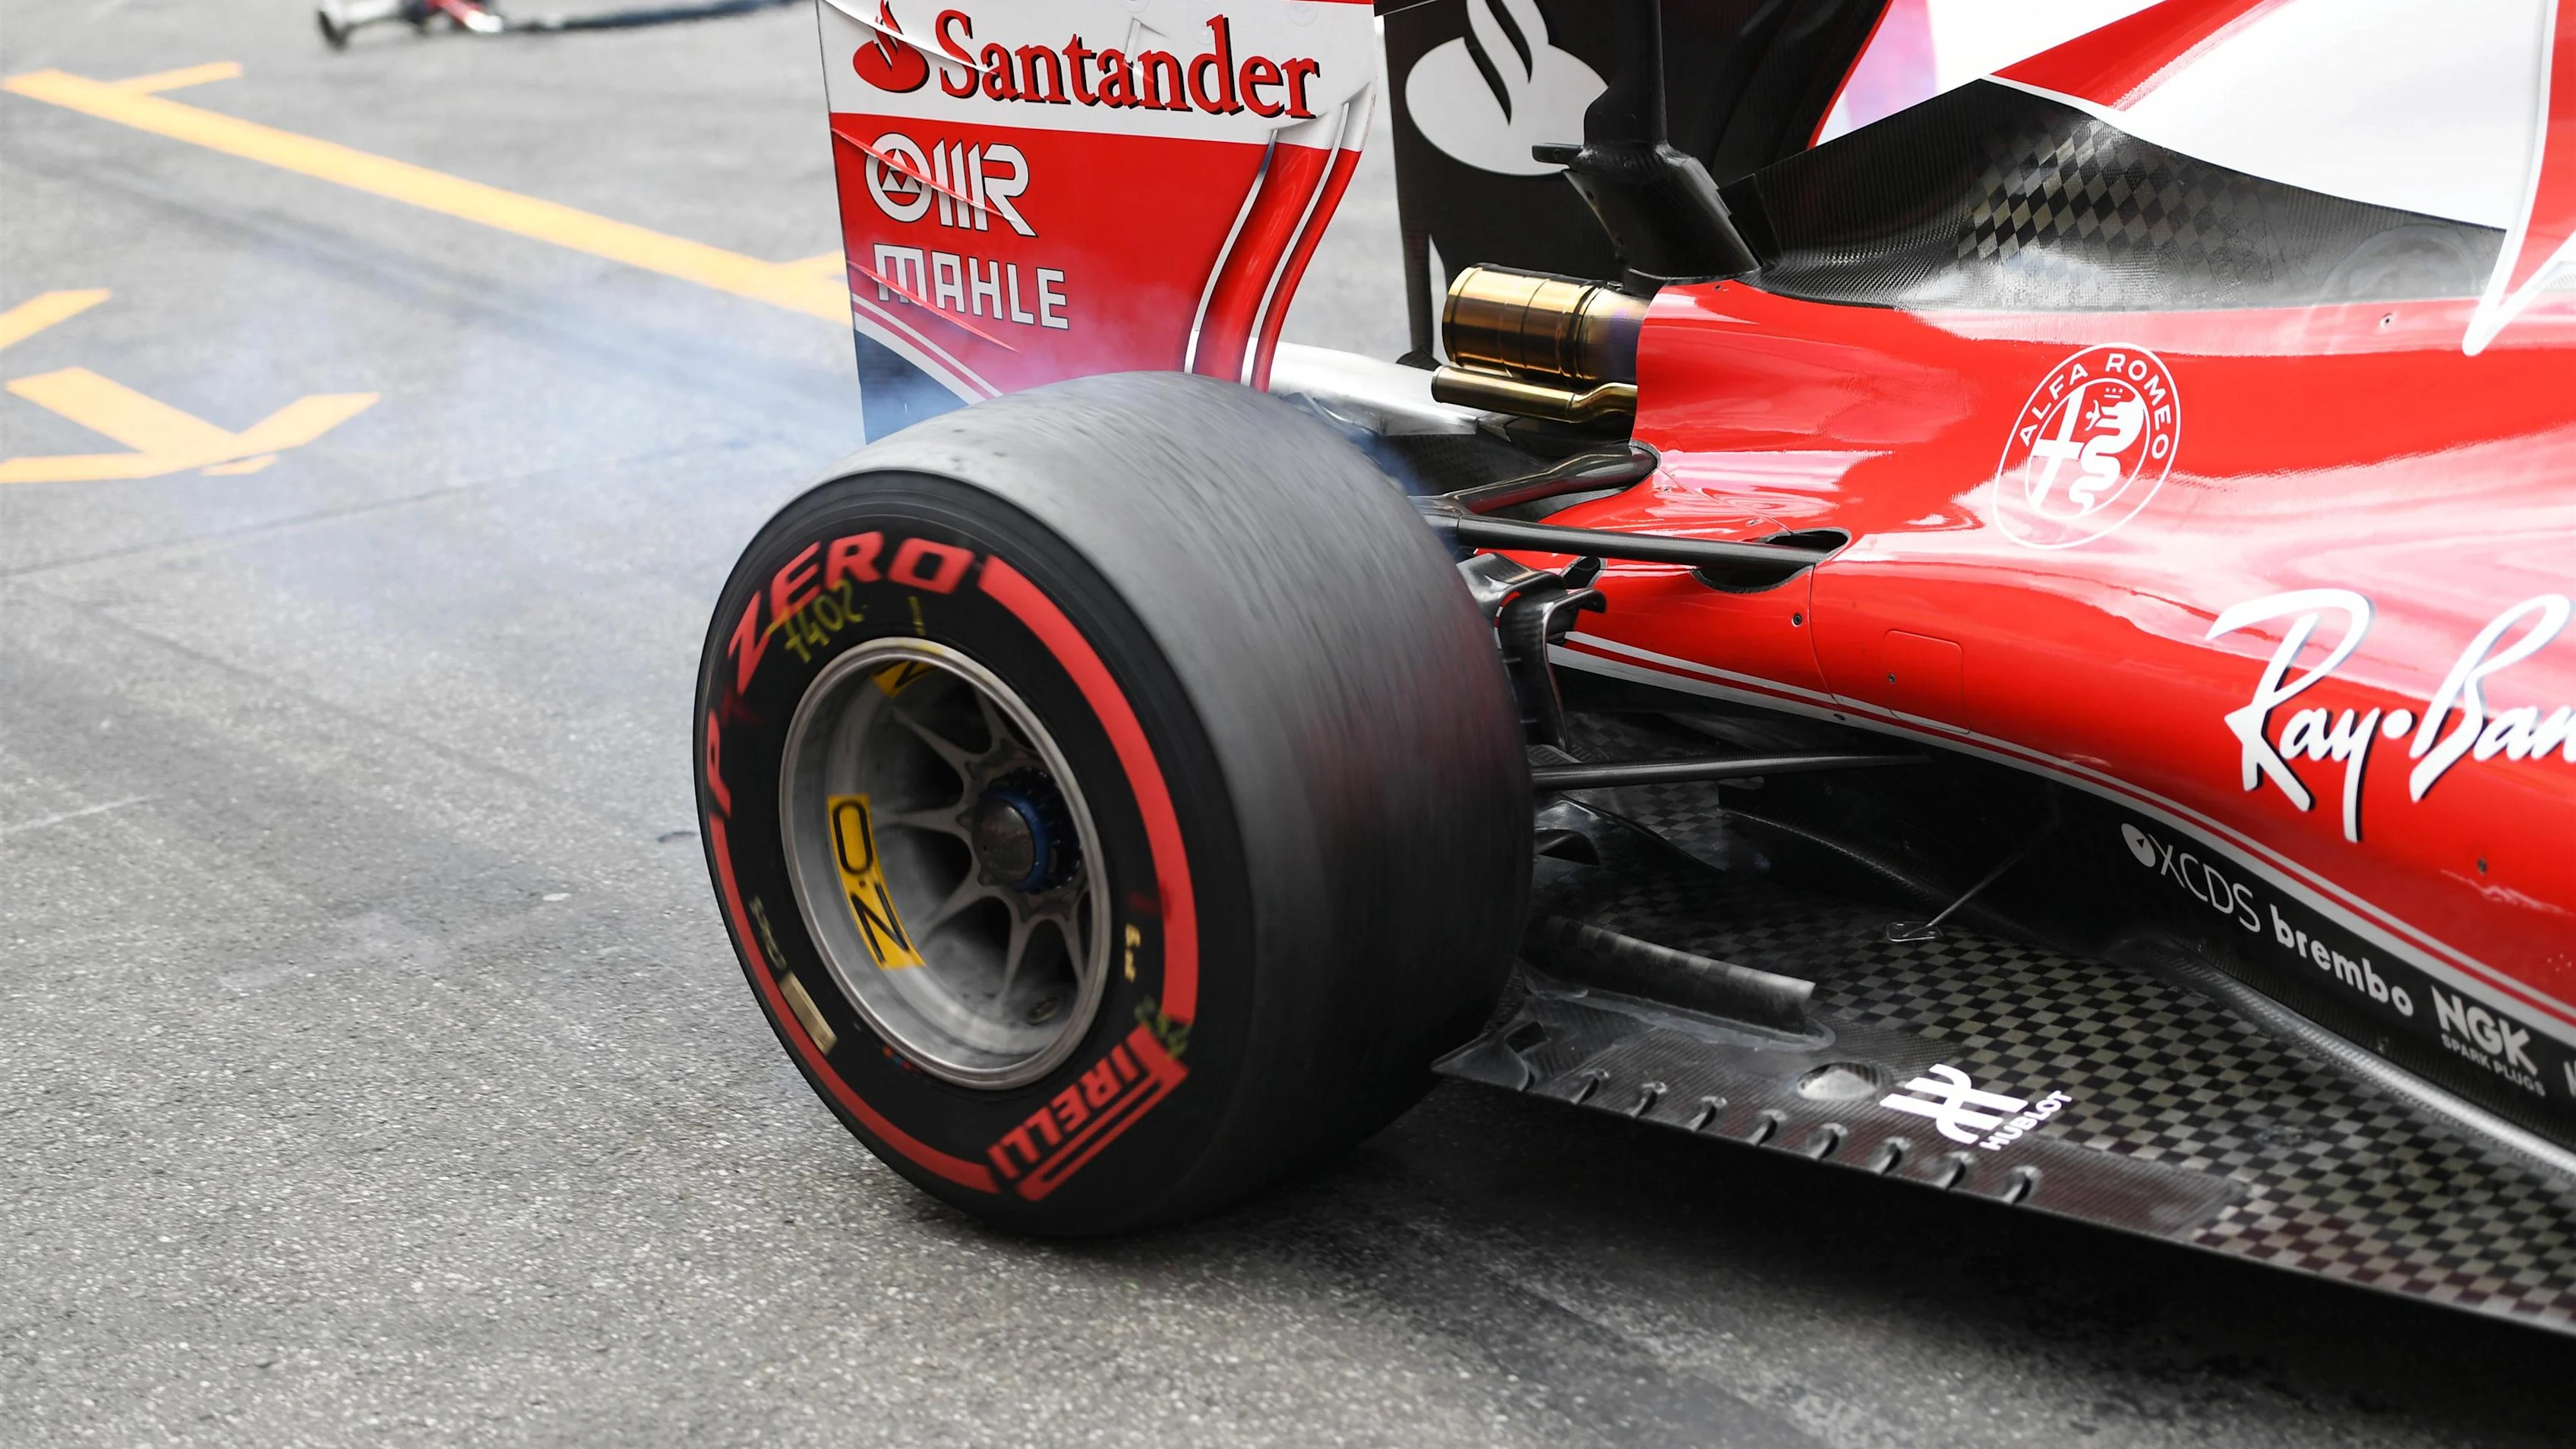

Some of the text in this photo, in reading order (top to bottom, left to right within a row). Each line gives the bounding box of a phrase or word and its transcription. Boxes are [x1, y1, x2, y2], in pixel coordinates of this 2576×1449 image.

[933, 8, 1320, 119] Santander
[873, 243, 1069, 330] MAHLE
[2018, 352, 2172, 460] ALFA ROMEO
[728, 530, 974, 697] ZERO
[2270, 904, 2414, 1017] brembo
[2430, 984, 2539, 1078] NGK
[2440, 1033, 2492, 1071] SPARK
[2492, 1059, 2546, 1097] PLUGS
[986, 1021, 1190, 1201] PIRELLI
[1978, 1090, 2073, 1151] HUBLOT
